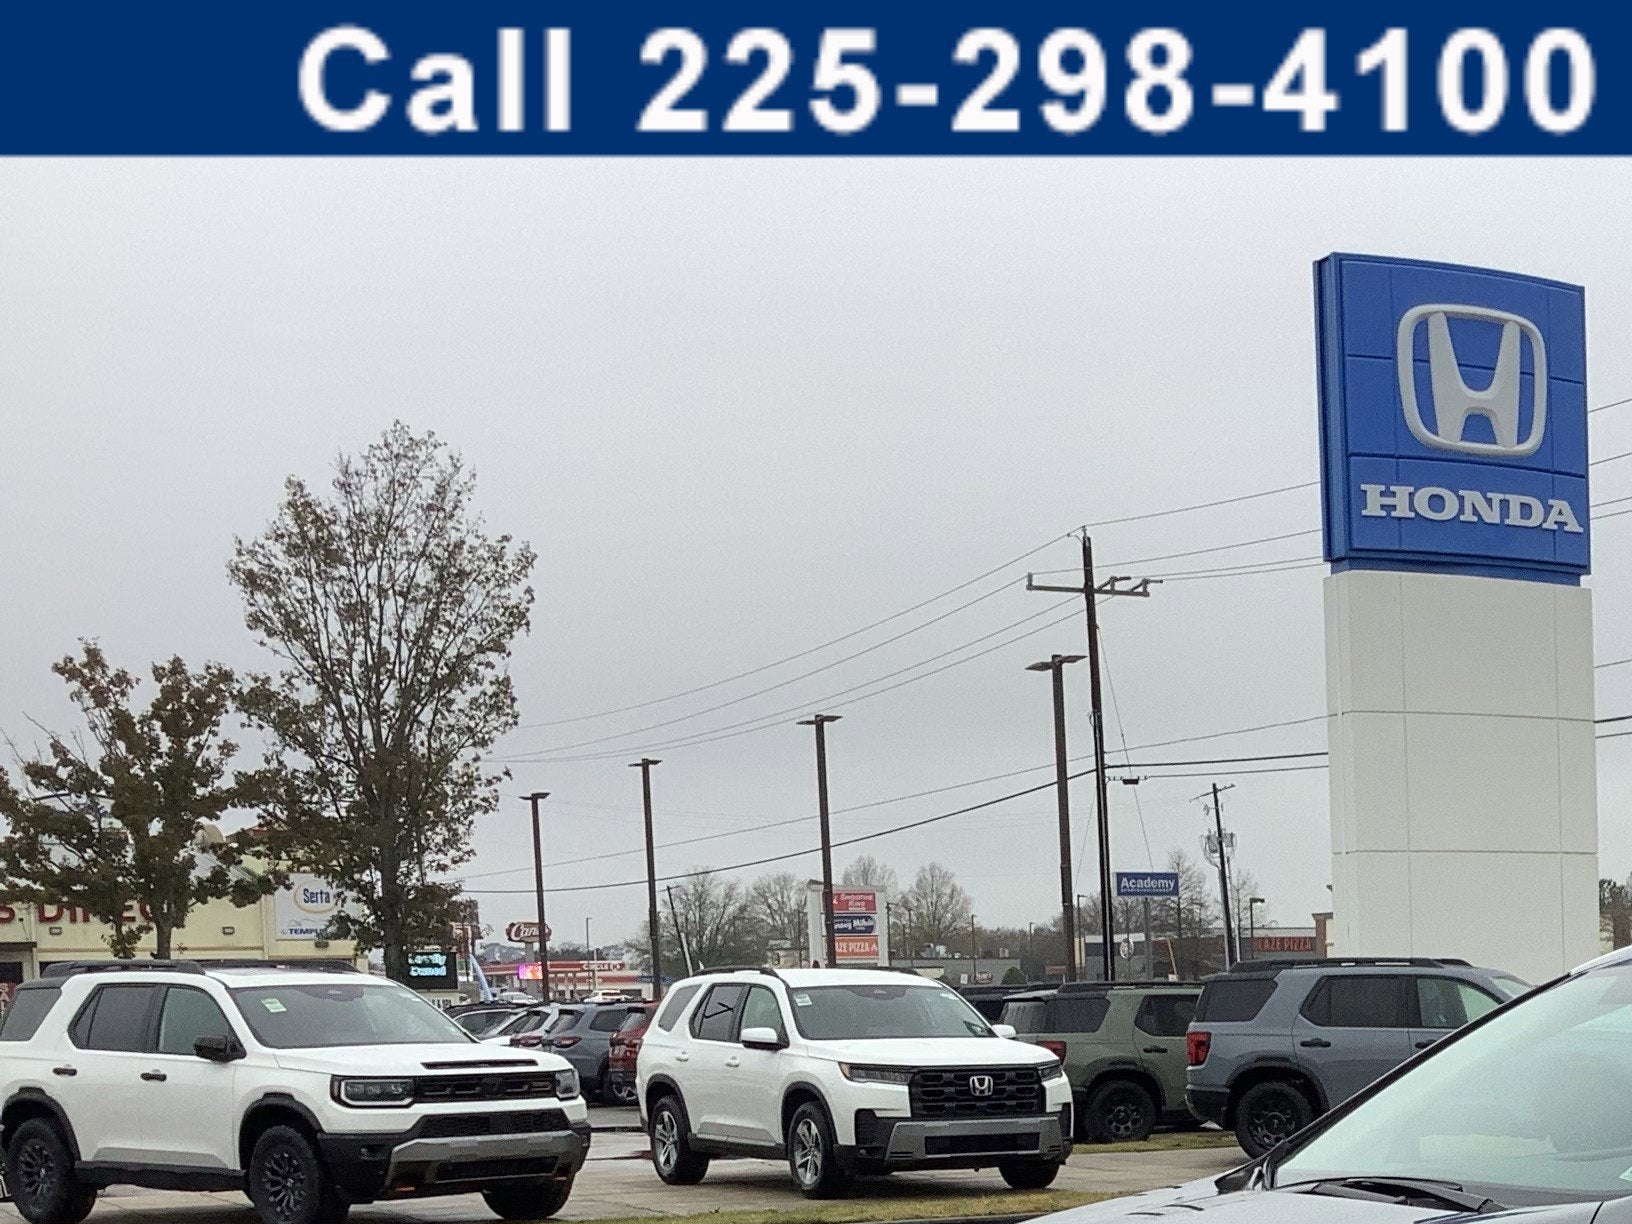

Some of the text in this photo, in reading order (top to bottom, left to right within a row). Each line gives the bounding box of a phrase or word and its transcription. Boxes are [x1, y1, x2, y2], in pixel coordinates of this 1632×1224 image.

[1360, 483, 1584, 534] HONDA
[1120, 876, 1176, 891] Academy
[303, 888, 331, 904] Serta
